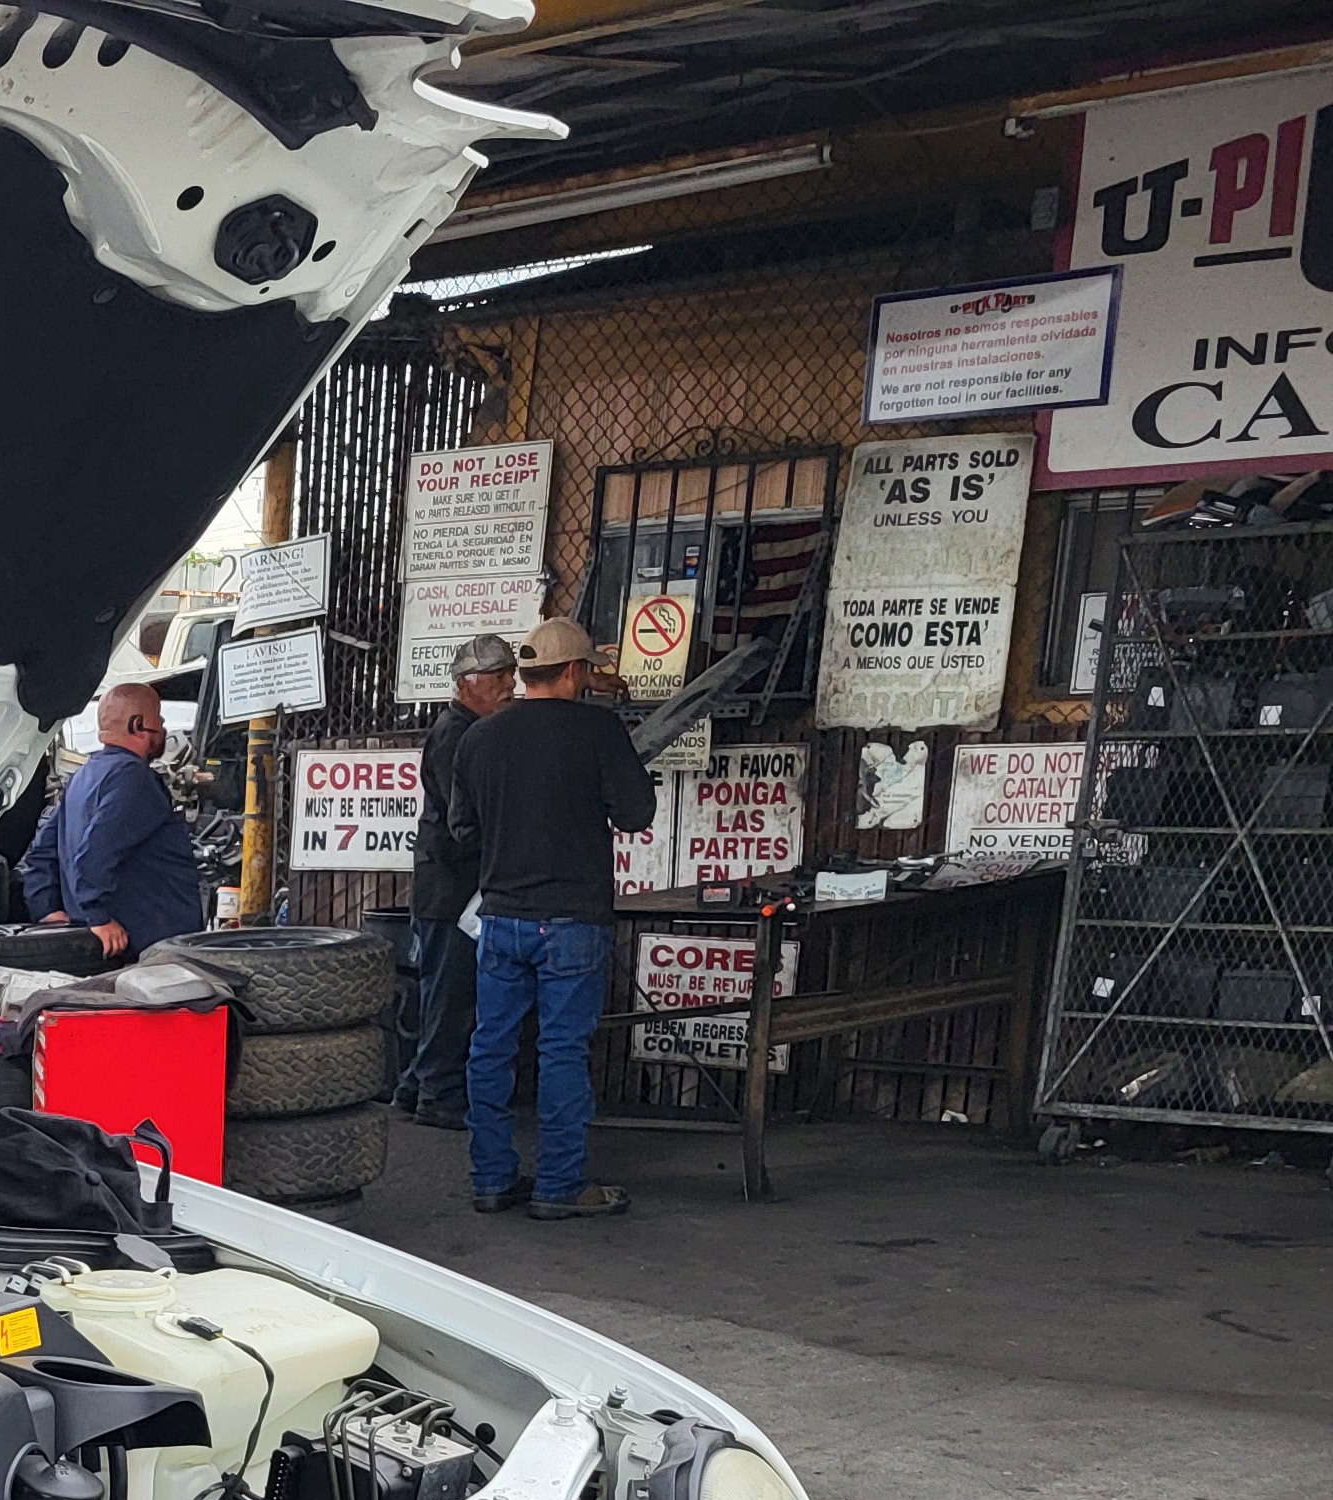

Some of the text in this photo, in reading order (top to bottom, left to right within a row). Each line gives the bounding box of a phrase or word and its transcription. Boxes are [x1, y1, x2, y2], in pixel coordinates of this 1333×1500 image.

[886, 310, 1097, 344] Nosotros no somos responsables
[884, 326, 1096, 362] por ninguna herramienta olvidada
[1193, 327, 1333, 371] INF
[883, 350, 1044, 376] en nuestras instalaciones.
[881, 367, 1071, 395] We are not responsible for any
[879, 383, 1063, 413] forgotten tool in our facilities.
[1132, 371, 1330, 449] CA
[420, 452, 538, 476] DO NOT LOSE
[862, 449, 1019, 475] ALL PARTS SOLD
[417, 469, 540, 492] YOUR RECEIPT
[433, 489, 520, 506] MAKE SURE YOU GET IT
[415, 501, 536, 520] NO PARTS RELEASED WITHOUT IT
[874, 509, 989, 527] UNLESS YOU
[413, 521, 533, 539] NO PIERDA SU RECIBO
[412, 545, 532, 561] TENERLO PORQUE NO SE
[413, 534, 532, 550] TENGA LA SEGURIDAD EN
[410, 556, 530, 572] DARAN PARTES SIN EL MISMO
[417, 579, 532, 600] CASH, CREDIT CARD
[429, 599, 518, 617] WHOLESALE
[843, 597, 1000, 617] TODA PARTE SE VENDE
[452, 620, 475, 628] TYPE
[643, 658, 663, 671] NO
[843, 655, 985, 669] A MENOS QUE USTED
[621, 675, 682, 688] SMOKING
[641, 689, 672, 698] FUMAR
[693, 754, 795, 779] OR FAVOR
[970, 754, 998, 775] WE
[1007, 753, 1034, 774] DO
[1045, 752, 1083, 773] NOT
[307, 763, 417, 790] CORES
[698, 782, 787, 806] PONGA
[1003, 777, 1082, 799] CATALYT
[305, 797, 417, 818] MUST BE RETURNED
[984, 802, 1075, 823] CONVERT
[716, 809, 765, 833] LAS
[303, 825, 417, 851] IN 7 DAYS
[689, 837, 789, 860] PARTES
[969, 835, 1073, 848] NO VENDE
[650, 945, 755, 972] CORE
[647, 973, 782, 996] MUST BE RETURD
[644, 1020, 749, 1041] DEBEN REGRES
[643, 1037, 777, 1061] COMPLETS
